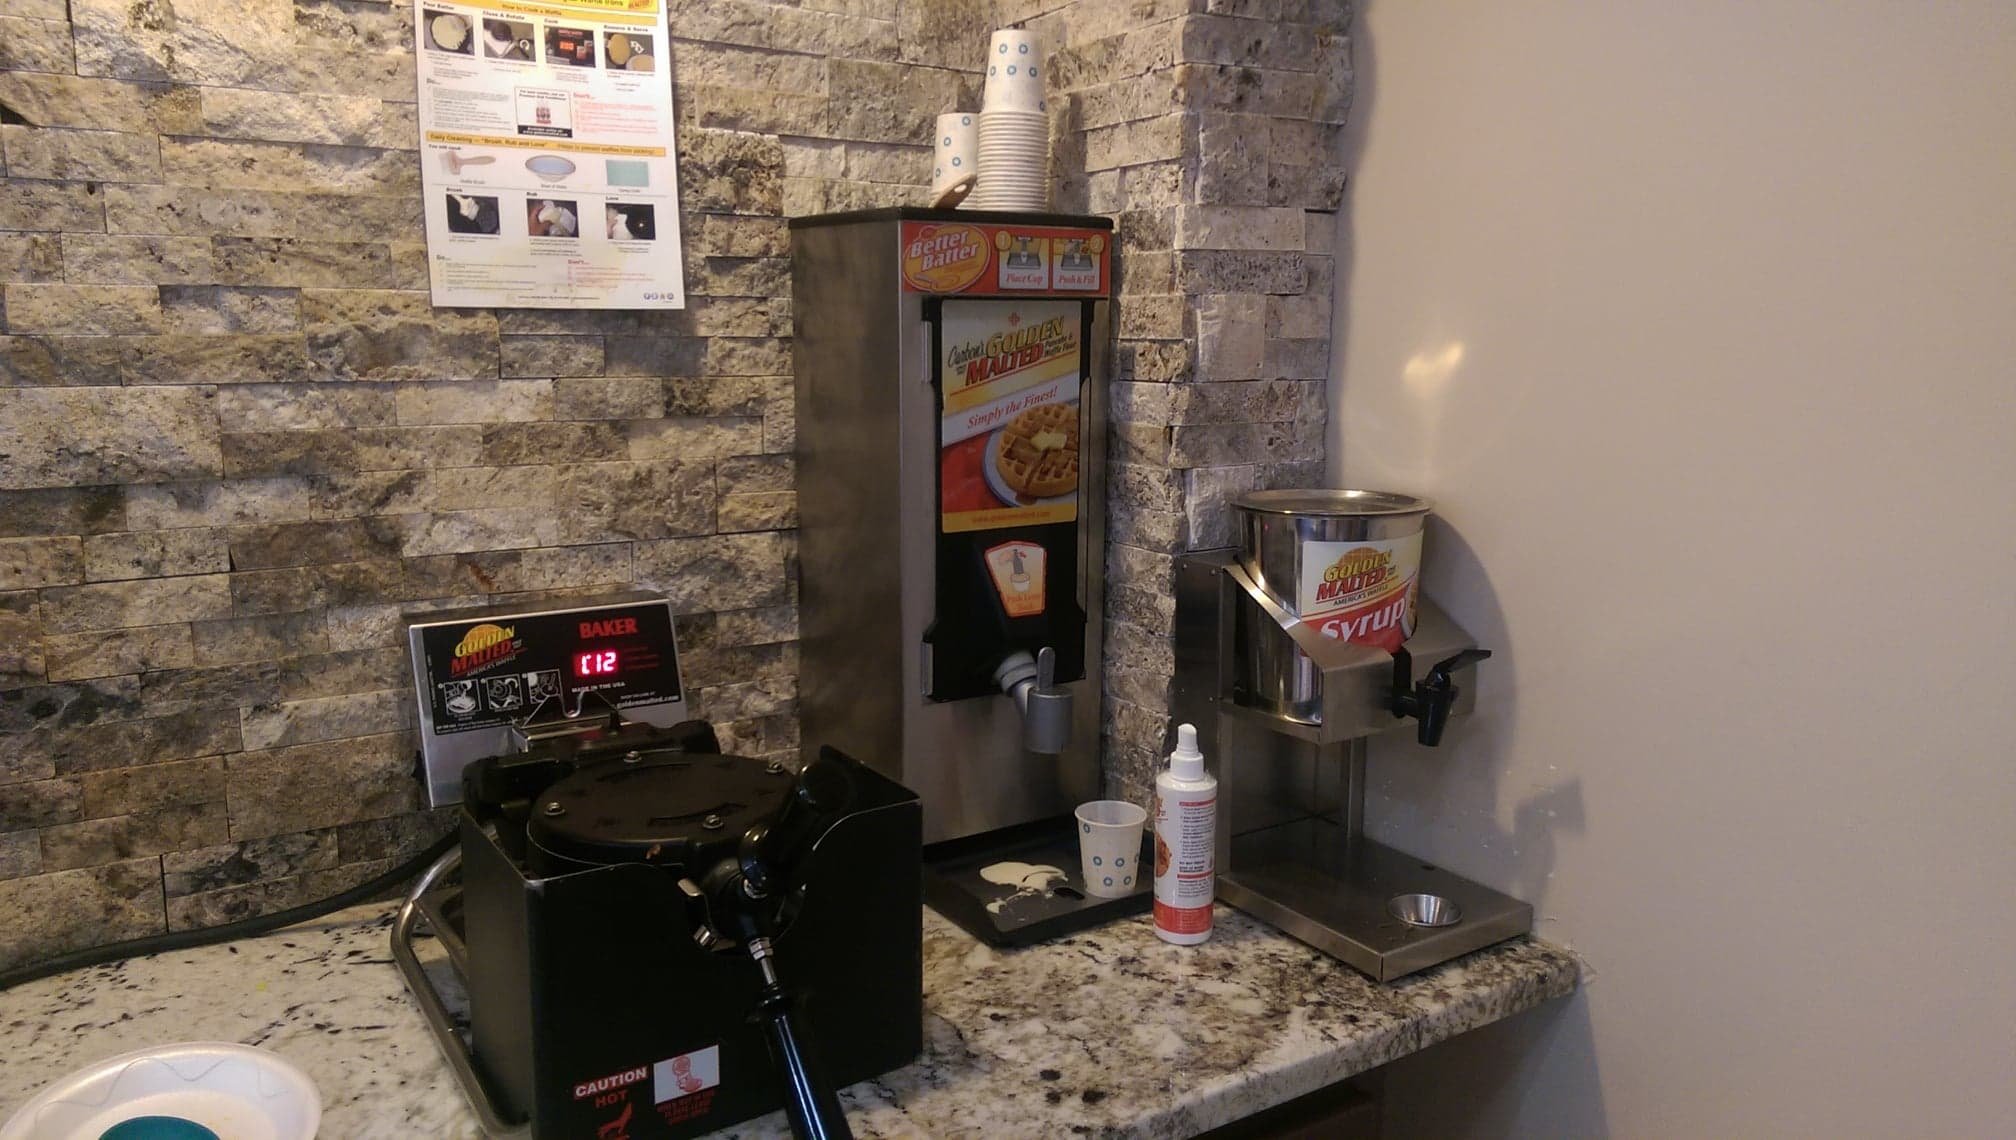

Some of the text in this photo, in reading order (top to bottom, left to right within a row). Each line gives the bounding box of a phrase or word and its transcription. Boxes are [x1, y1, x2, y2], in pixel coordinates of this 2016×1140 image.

[910, 230, 968, 259] Better
[921, 243, 978, 273] Batter
[985, 315, 1065, 359] GOLDEN
[965, 343, 1044, 386] MALTED
[968, 385, 1058, 429] Simply the Finest!
[1324, 551, 1392, 582] GOLDEN
[1316, 567, 1388, 601] MALTED
[580, 618, 638, 639] BAKER
[1321, 598, 1405, 642] Syrup
[450, 638, 513, 676] MALTED
[455, 625, 515, 658] GOLDEN
[575, 1067, 648, 1097] CAUTION
[595, 1090, 628, 1108] HOT
